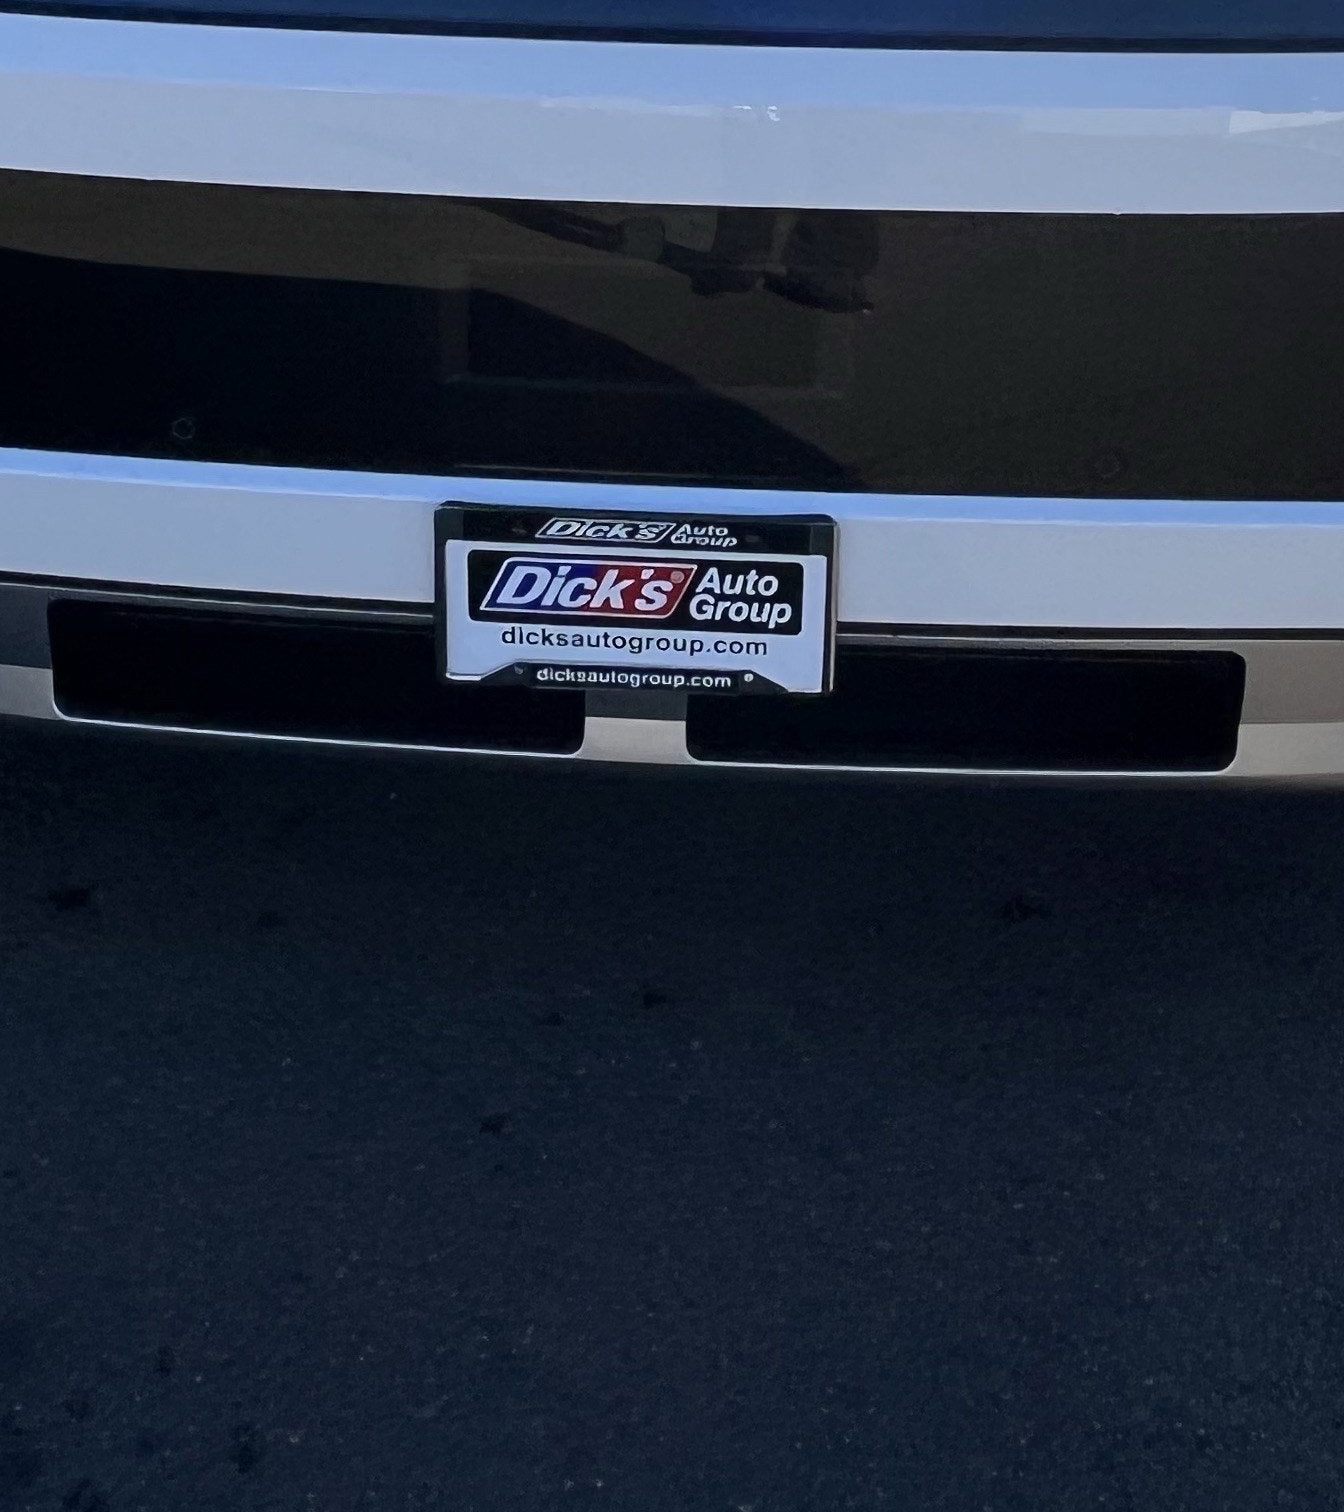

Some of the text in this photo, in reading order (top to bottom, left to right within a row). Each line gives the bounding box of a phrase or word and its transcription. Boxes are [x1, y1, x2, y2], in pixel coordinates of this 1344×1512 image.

[670, 534, 738, 548] Group
[674, 523, 729, 537] Auto
[496, 564, 779, 612] Dick's Auto
[688, 594, 793, 629] Group
[500, 626, 768, 656] dicksautogroup.com
[536, 667, 732, 689] dicksautogroup.com
